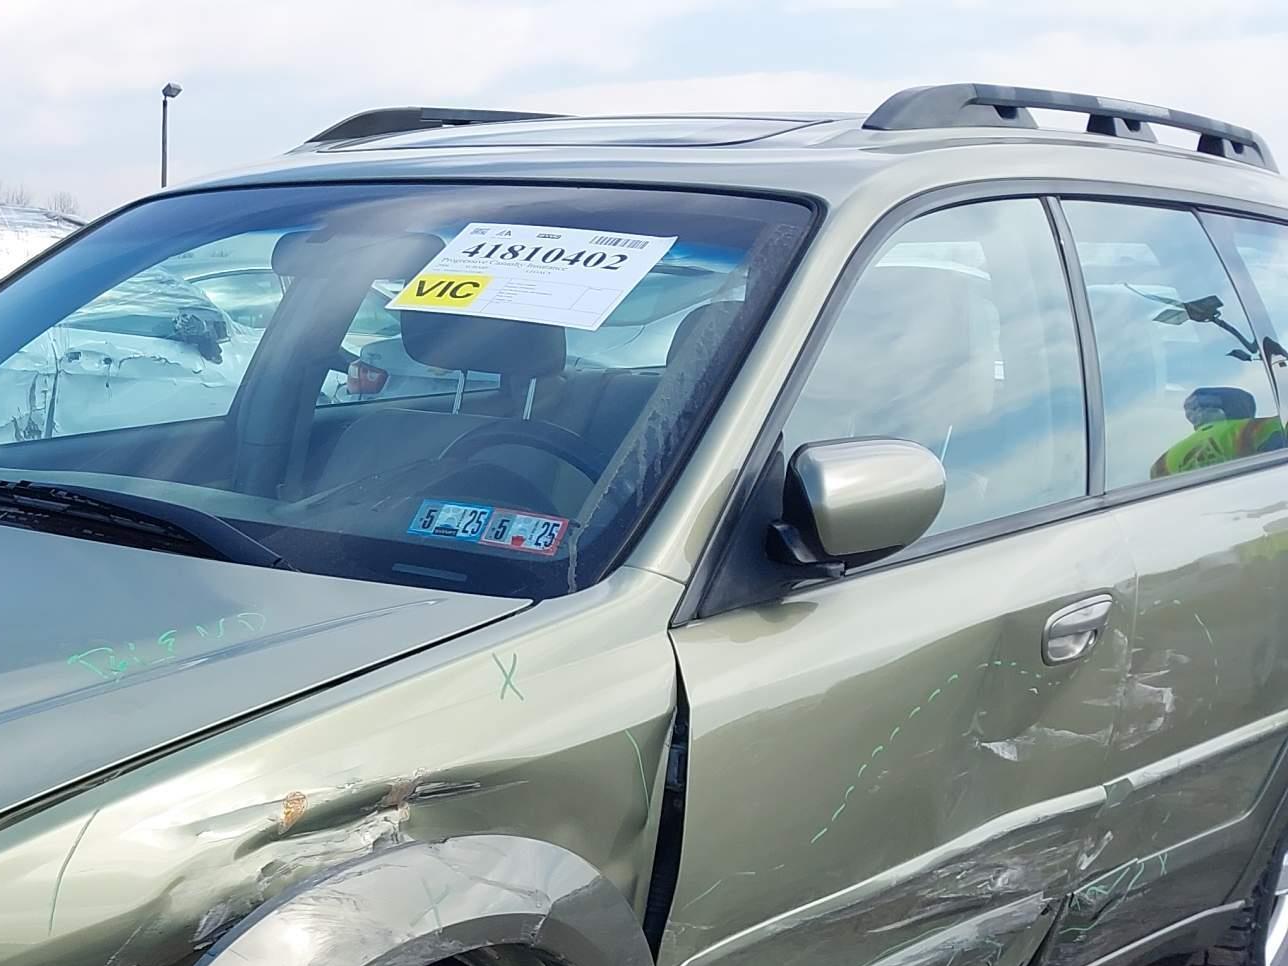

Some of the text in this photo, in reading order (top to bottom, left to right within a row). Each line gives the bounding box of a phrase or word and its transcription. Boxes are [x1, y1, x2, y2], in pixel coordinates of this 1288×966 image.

[462, 242, 629, 271] 41810402
[415, 279, 480, 299] VIC
[462, 510, 488, 535] 25
[534, 521, 560, 547] 25
